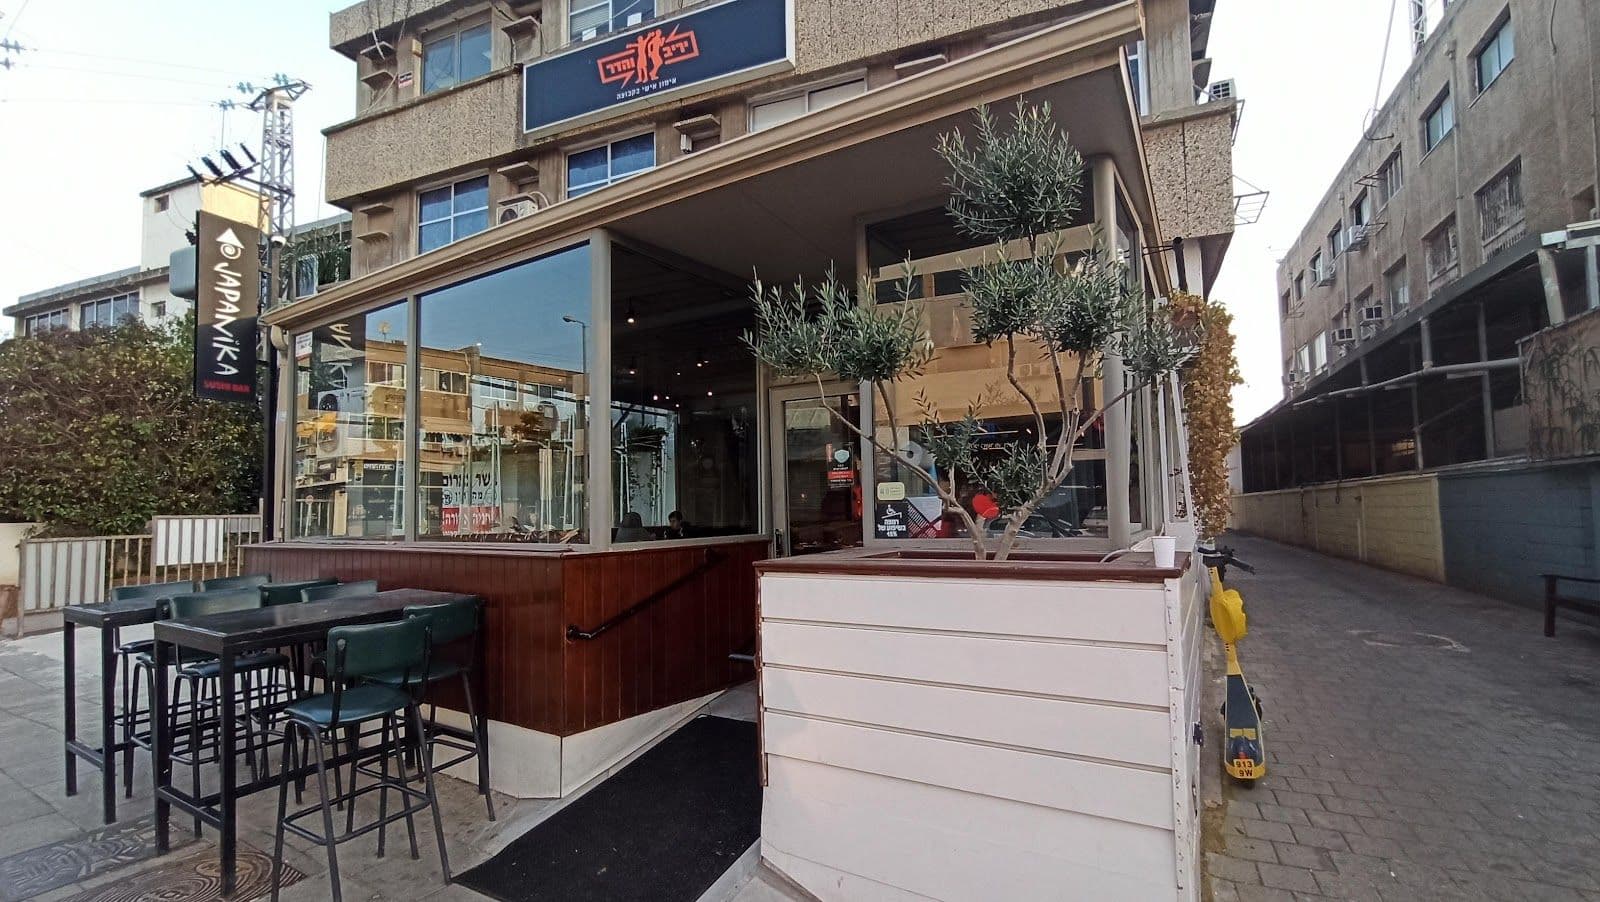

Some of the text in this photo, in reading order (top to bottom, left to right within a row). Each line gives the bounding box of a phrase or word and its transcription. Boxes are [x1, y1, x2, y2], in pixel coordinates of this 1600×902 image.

[616, 77, 677, 100] אימון אישי בקבוצה
[212, 262, 242, 375] JAPANIKA
[1235, 760, 1253, 768] 913
